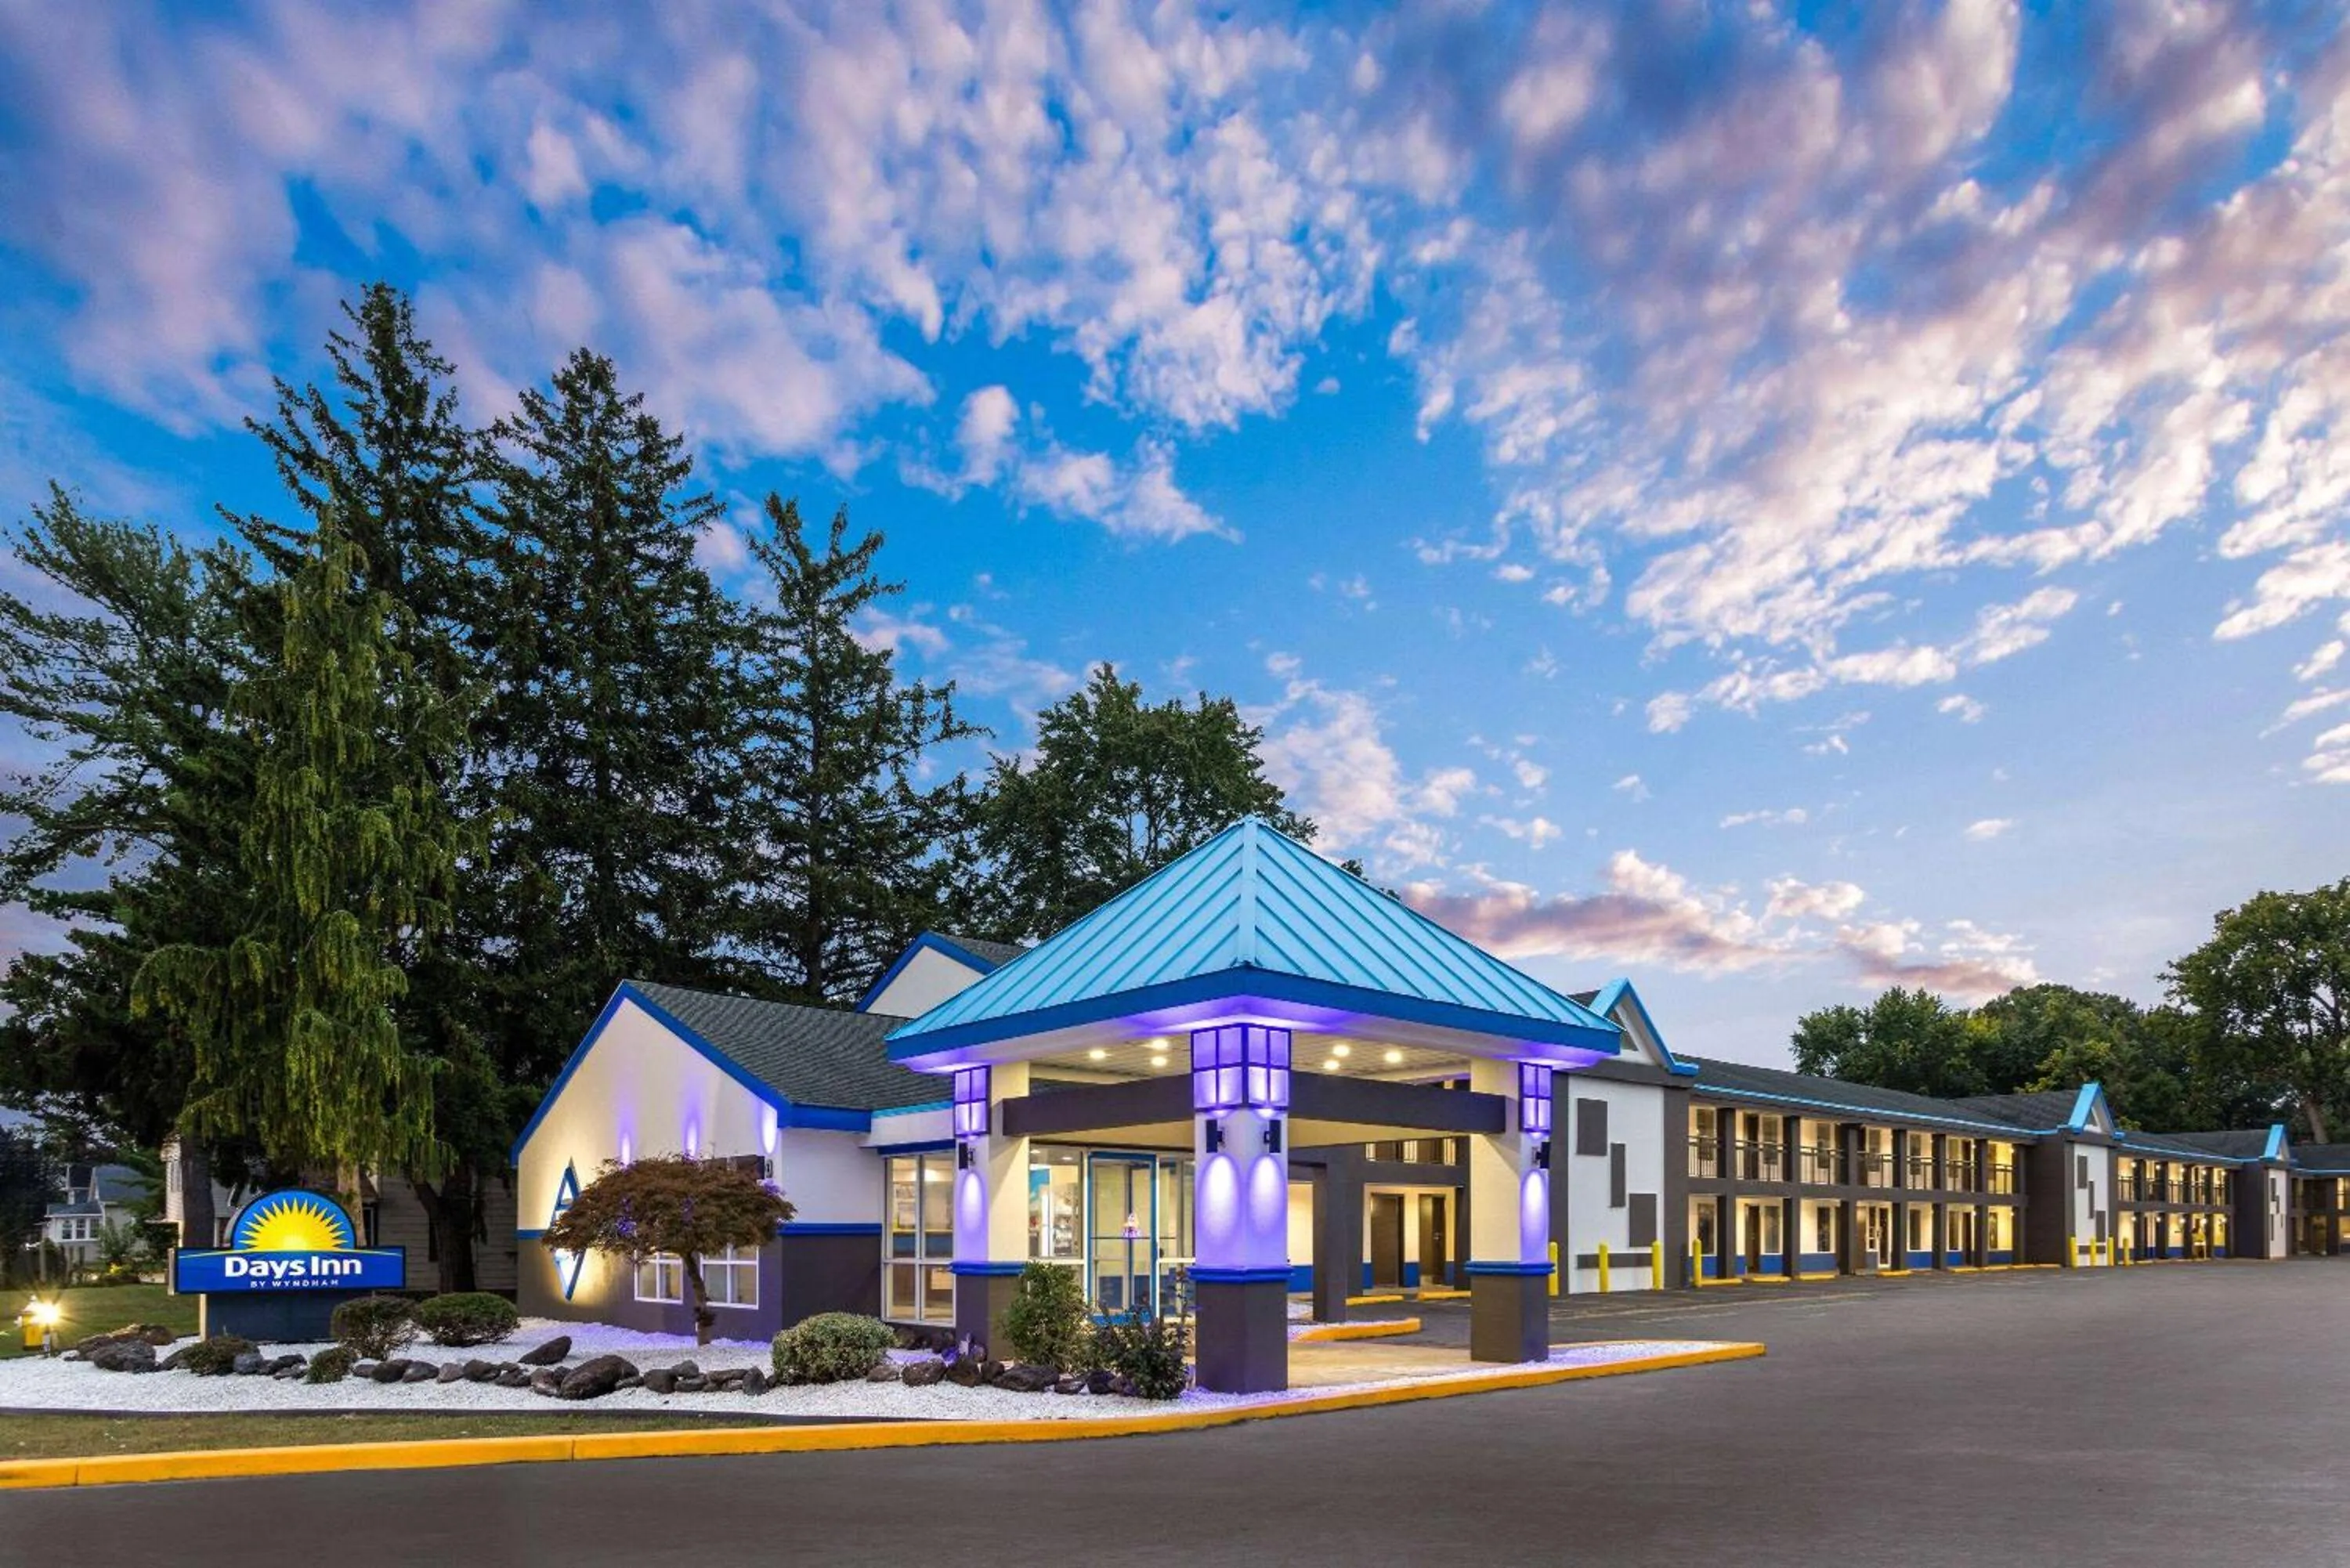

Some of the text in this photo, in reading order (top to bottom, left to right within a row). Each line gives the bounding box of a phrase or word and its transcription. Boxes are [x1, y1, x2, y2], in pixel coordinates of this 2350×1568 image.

[224, 1255, 363, 1279] Days Inn
[272, 1279, 339, 1288] WYNDHAM
